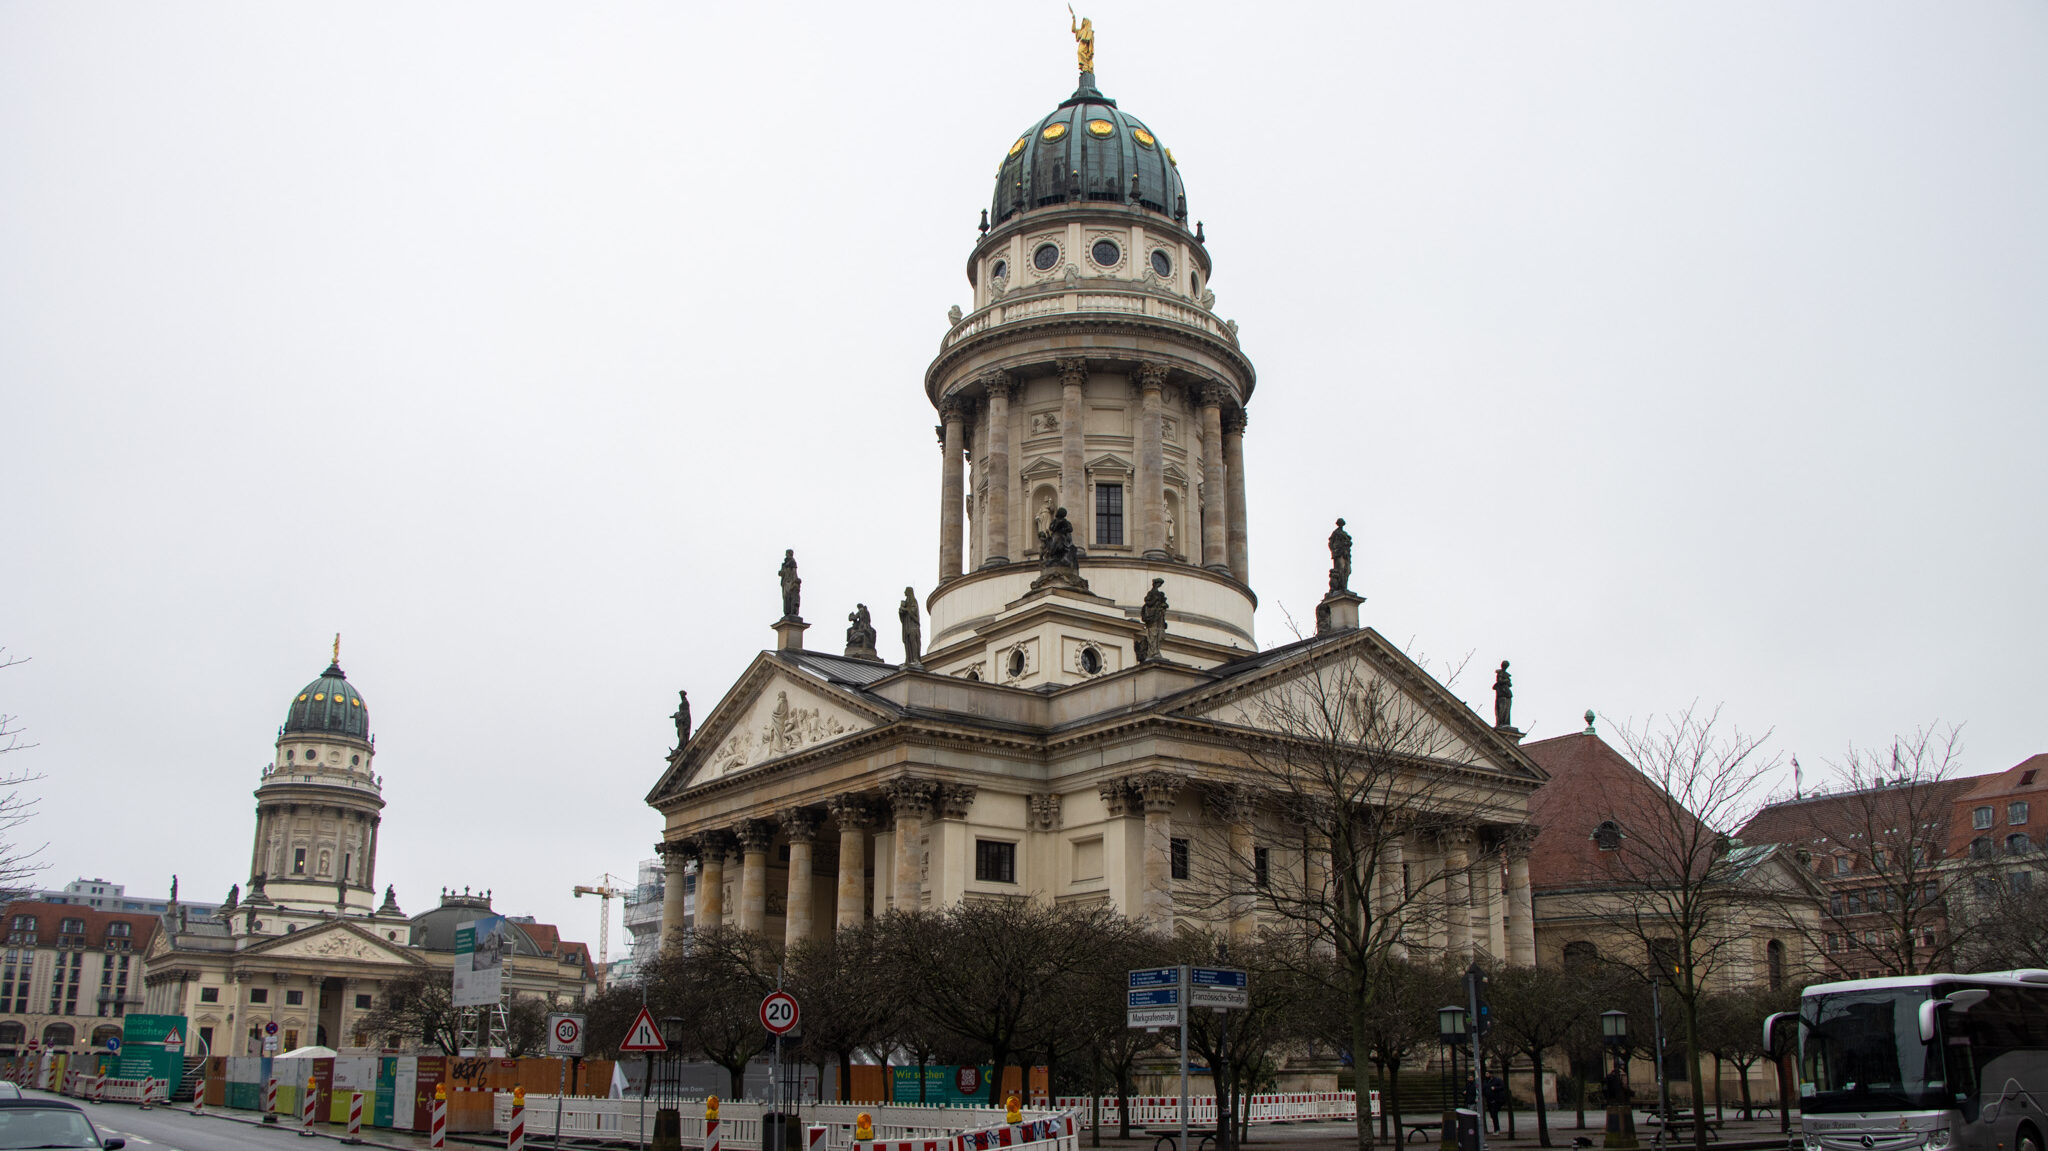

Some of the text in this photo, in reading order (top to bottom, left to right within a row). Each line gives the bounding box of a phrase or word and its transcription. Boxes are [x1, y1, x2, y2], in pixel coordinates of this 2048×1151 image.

[1192, 991, 1244, 1005] Französische Straße
[769, 1003, 791, 1020] 20
[1132, 1012, 1175, 1024] Markgrafenstraße
[560, 1025, 574, 1037] 30
[556, 1044, 575, 1052] ZONE
[895, 1069, 911, 1079] Wir
